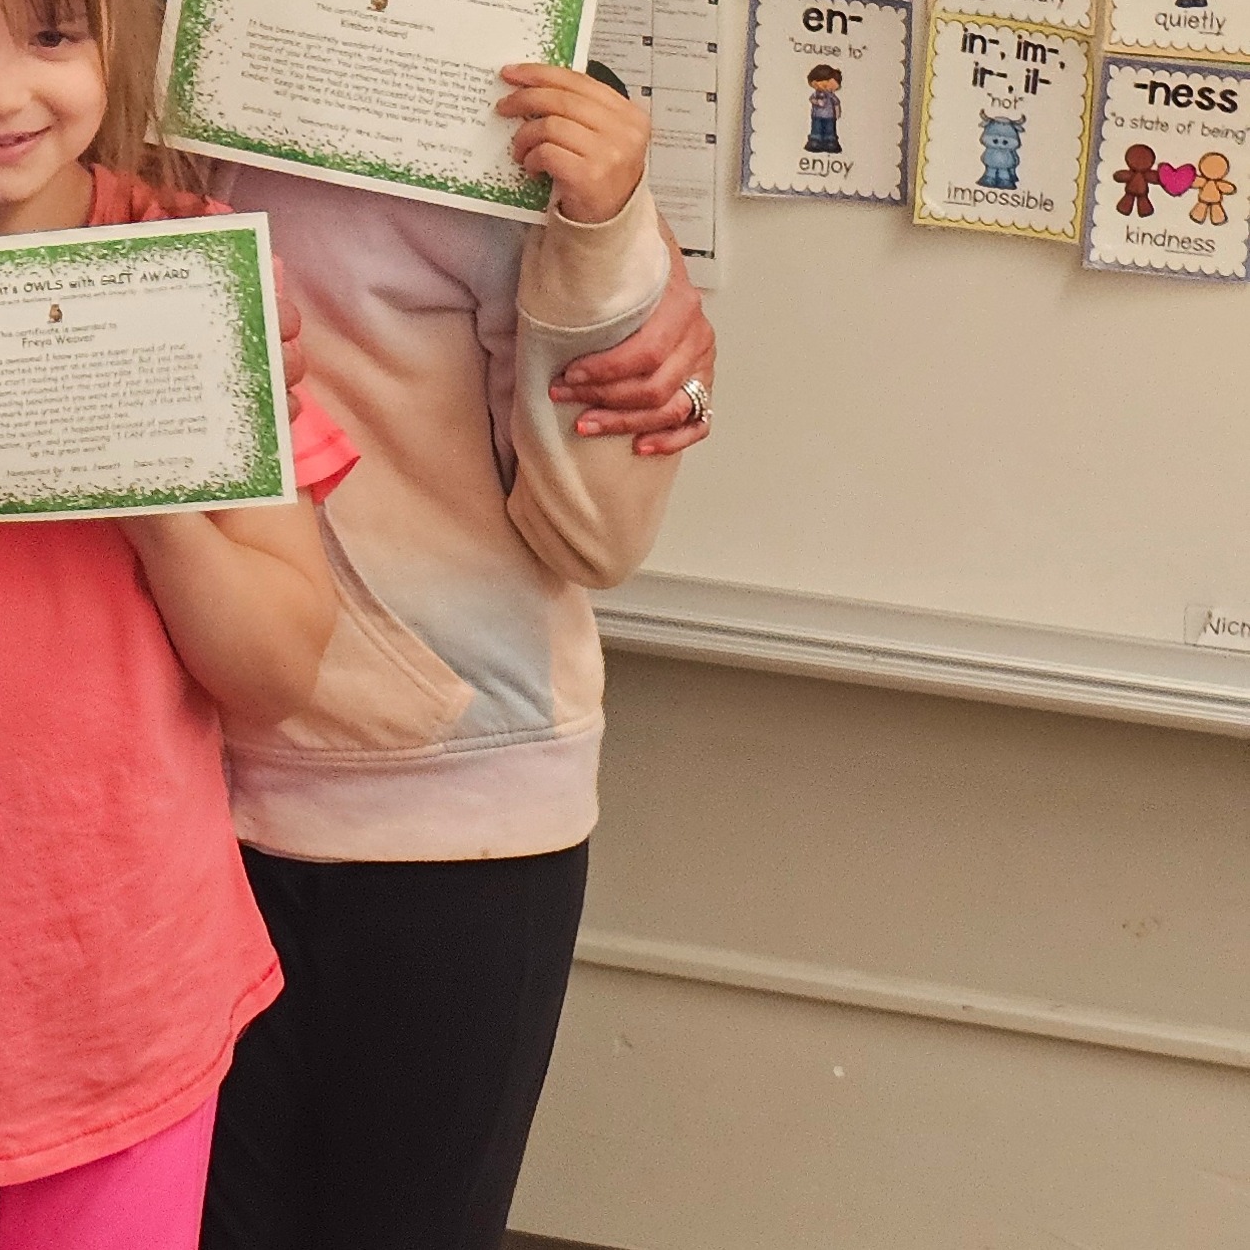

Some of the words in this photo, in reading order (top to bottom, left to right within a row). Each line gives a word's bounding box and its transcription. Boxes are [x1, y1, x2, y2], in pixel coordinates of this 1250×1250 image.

[802, 4, 863, 35] en-
[1155, 11, 1226, 35] quietly
[961, 27, 1006, 60] in-,
[1015, 34, 1066, 70] im-,
[972, 60, 1014, 94] ir-,
[1024, 67, 1052, 95] il-
[1134, 80, 1238, 113] -ness
[1129, 115, 1169, 133] state
[1175, 120, 1195, 135] of
[797, 156, 854, 179] enjoy
[945, 187, 1054, 212] impossible
[1126, 226, 1216, 256] kindness
[23, 279, 63, 293] OWLS
[69, 276, 95, 289] with
[100, 272, 133, 286] GRIT
[140, 268, 191, 282] AWARD
